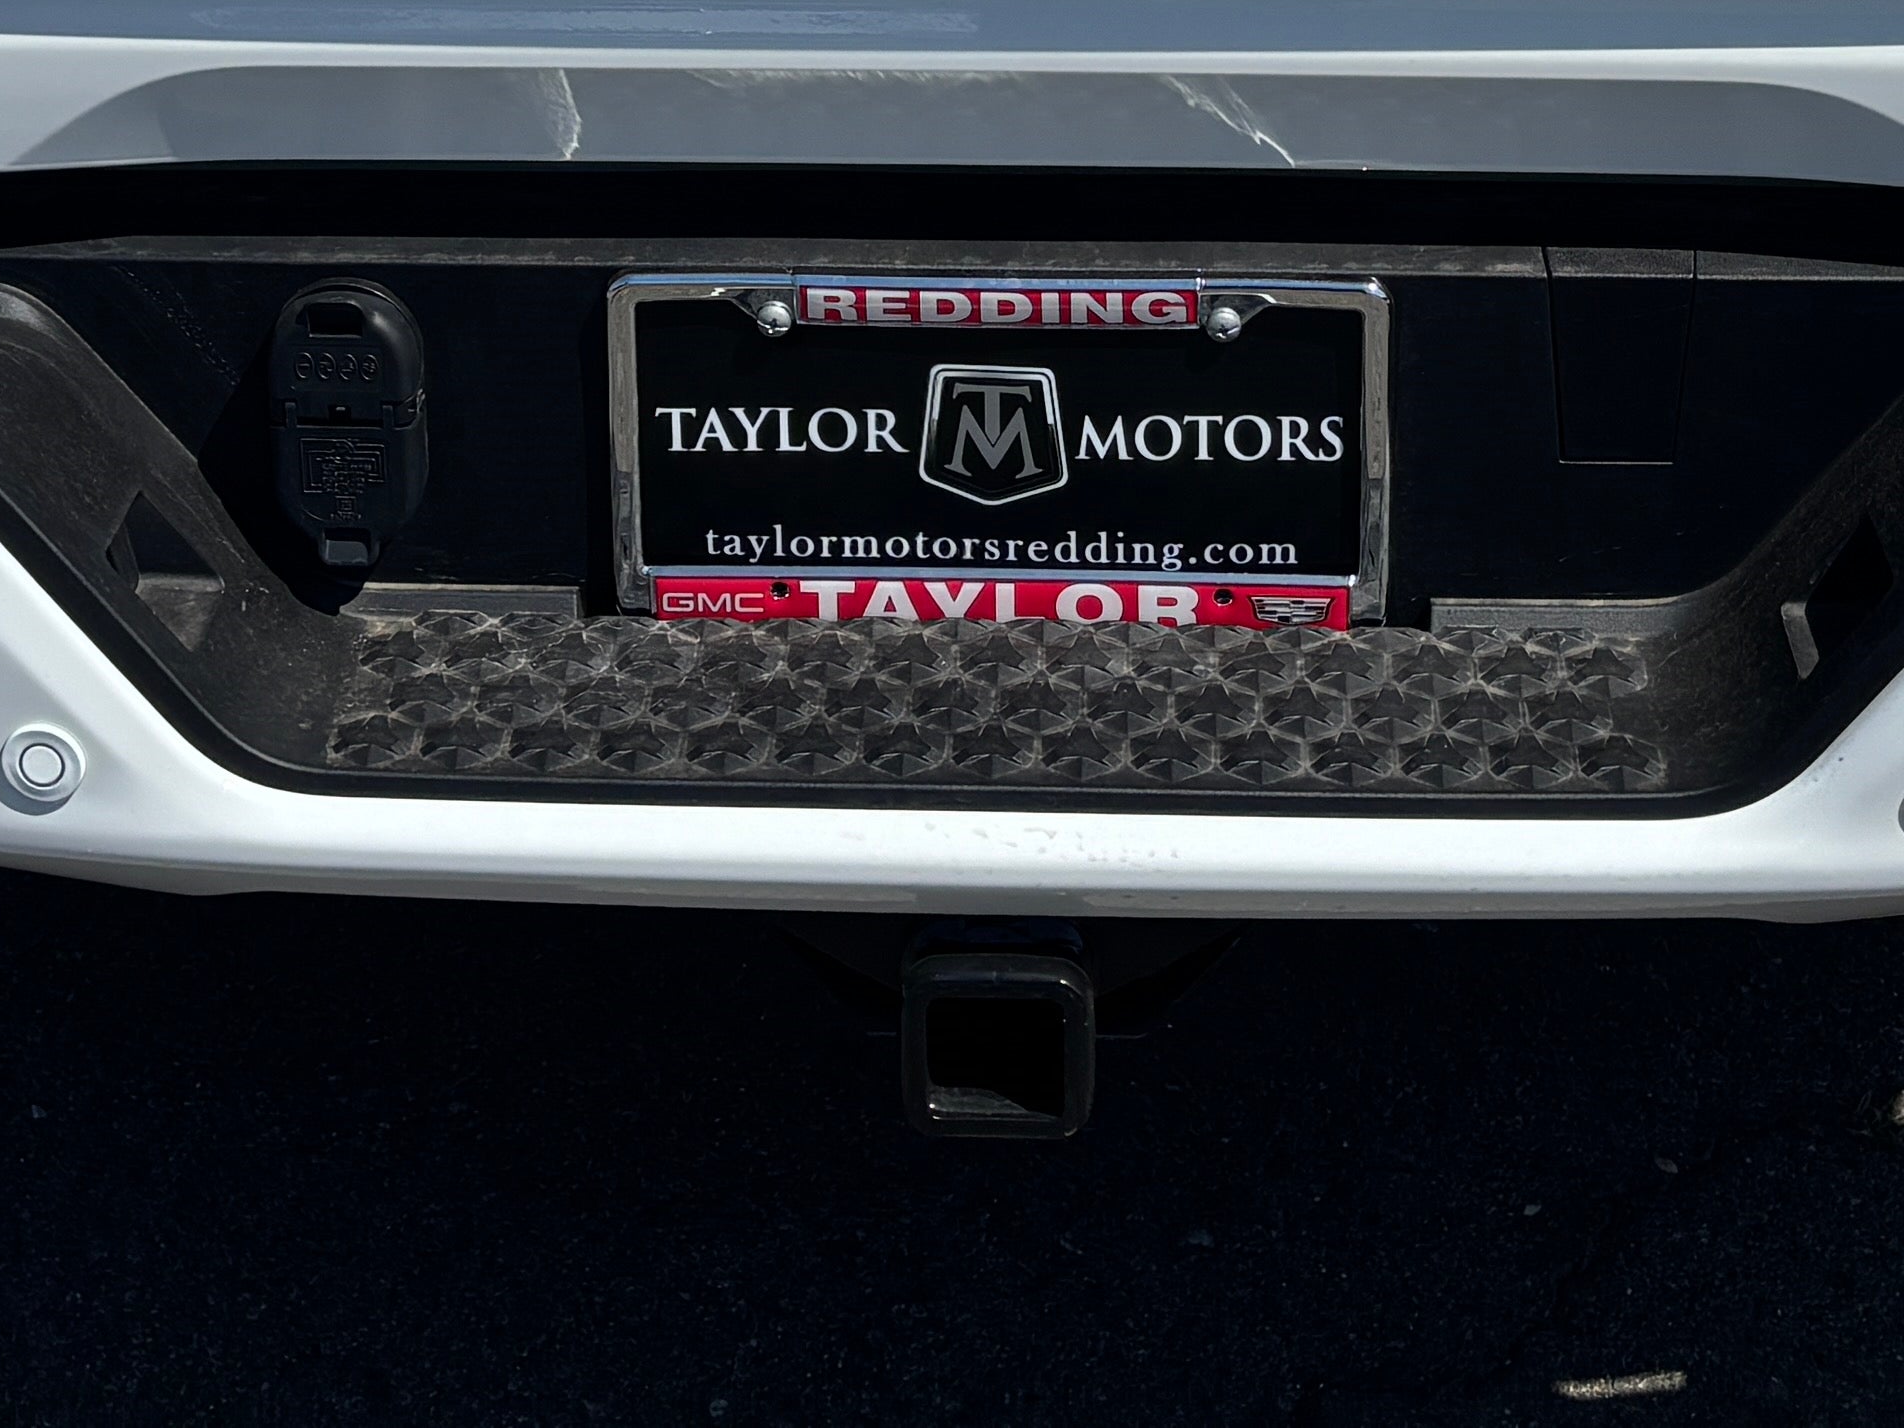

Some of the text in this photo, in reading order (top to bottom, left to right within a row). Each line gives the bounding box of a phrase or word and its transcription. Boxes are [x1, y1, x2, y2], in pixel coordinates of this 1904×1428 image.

[806, 288, 1188, 324] REDDING
[655, 407, 909, 453] TAYLOR
[1075, 414, 1345, 462] MOTORS
[705, 525, 1298, 571] taylormotorsredding.com
[662, 580, 1200, 628] GMC TAYLOR
